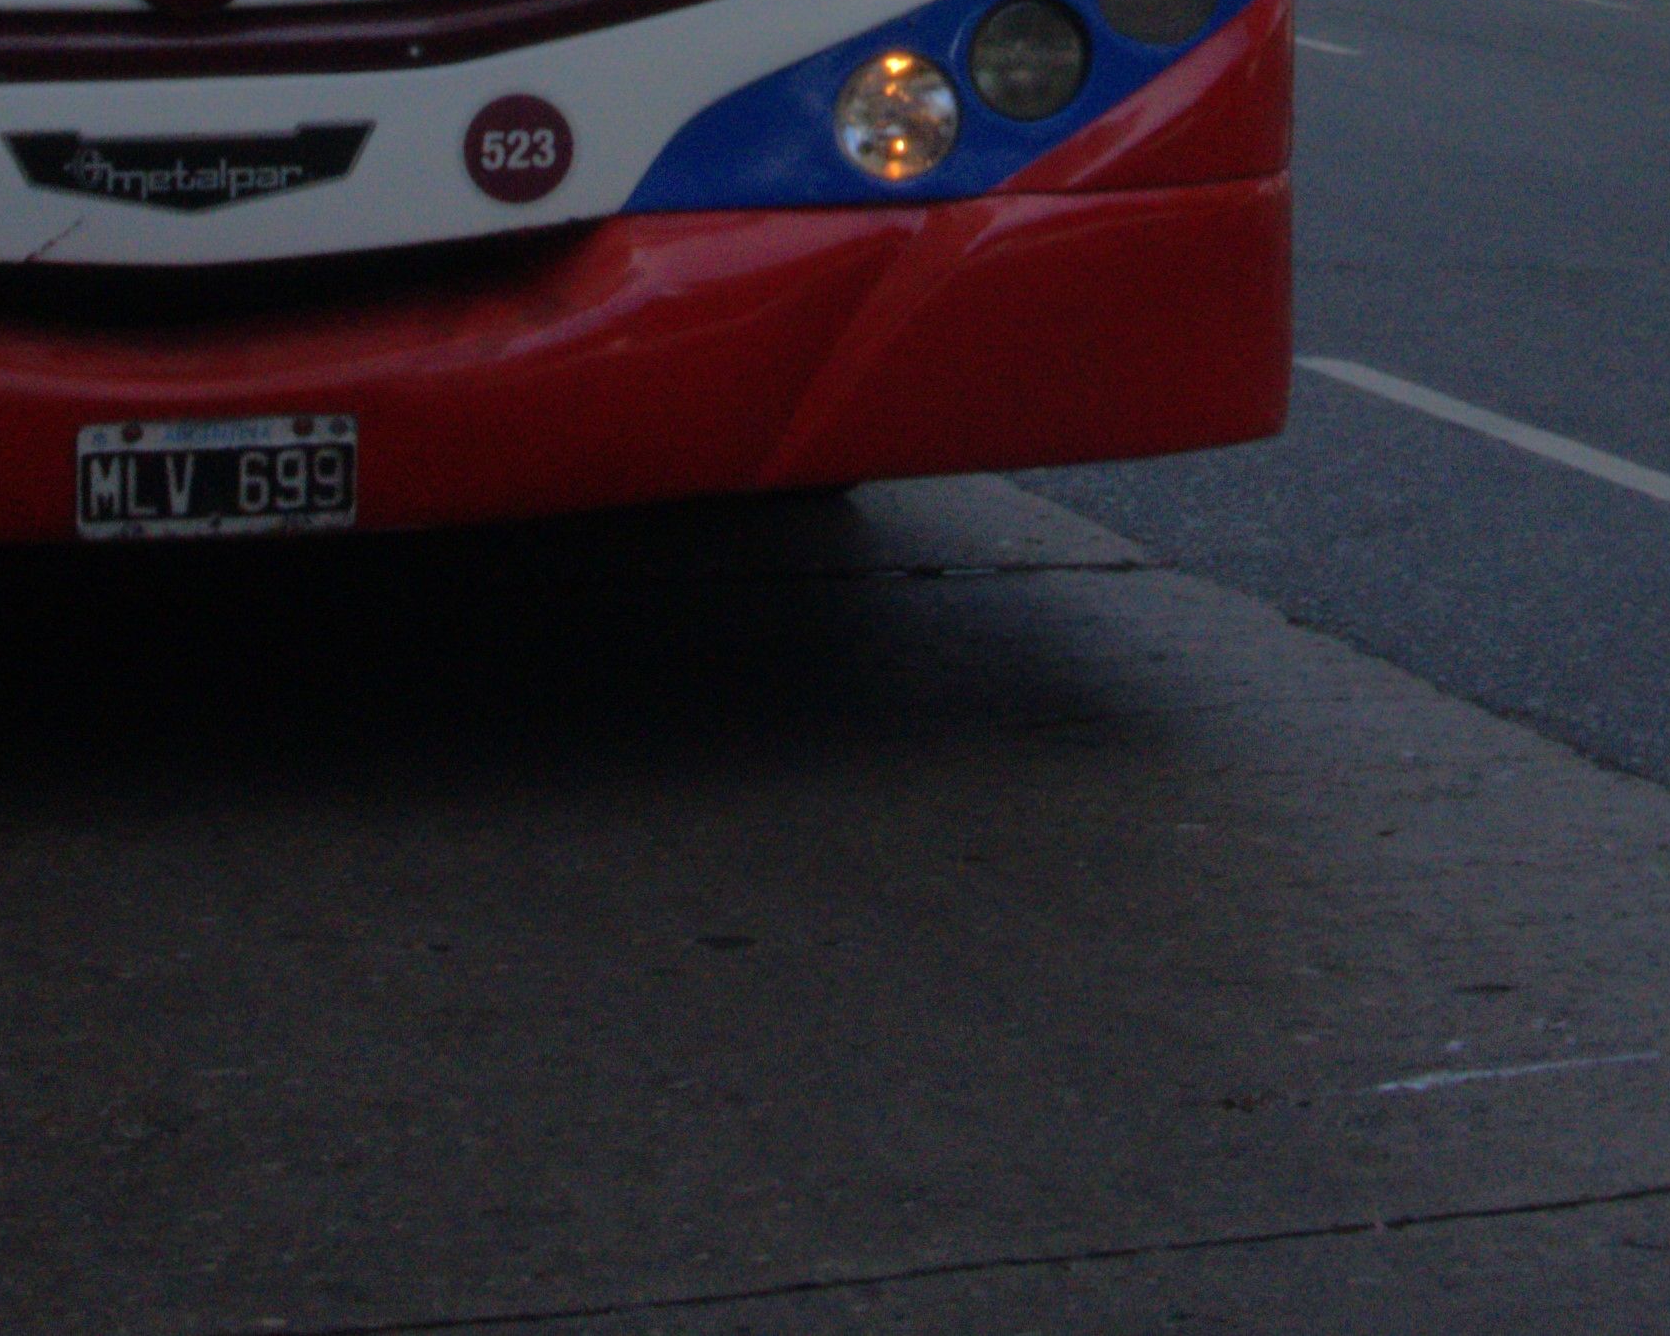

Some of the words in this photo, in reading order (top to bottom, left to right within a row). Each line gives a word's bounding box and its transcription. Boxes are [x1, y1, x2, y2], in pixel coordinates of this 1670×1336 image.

[480, 126, 556, 171] 523
[106, 156, 303, 200] metalpar
[88, 452, 196, 519] MLV
[236, 446, 348, 515] 699
